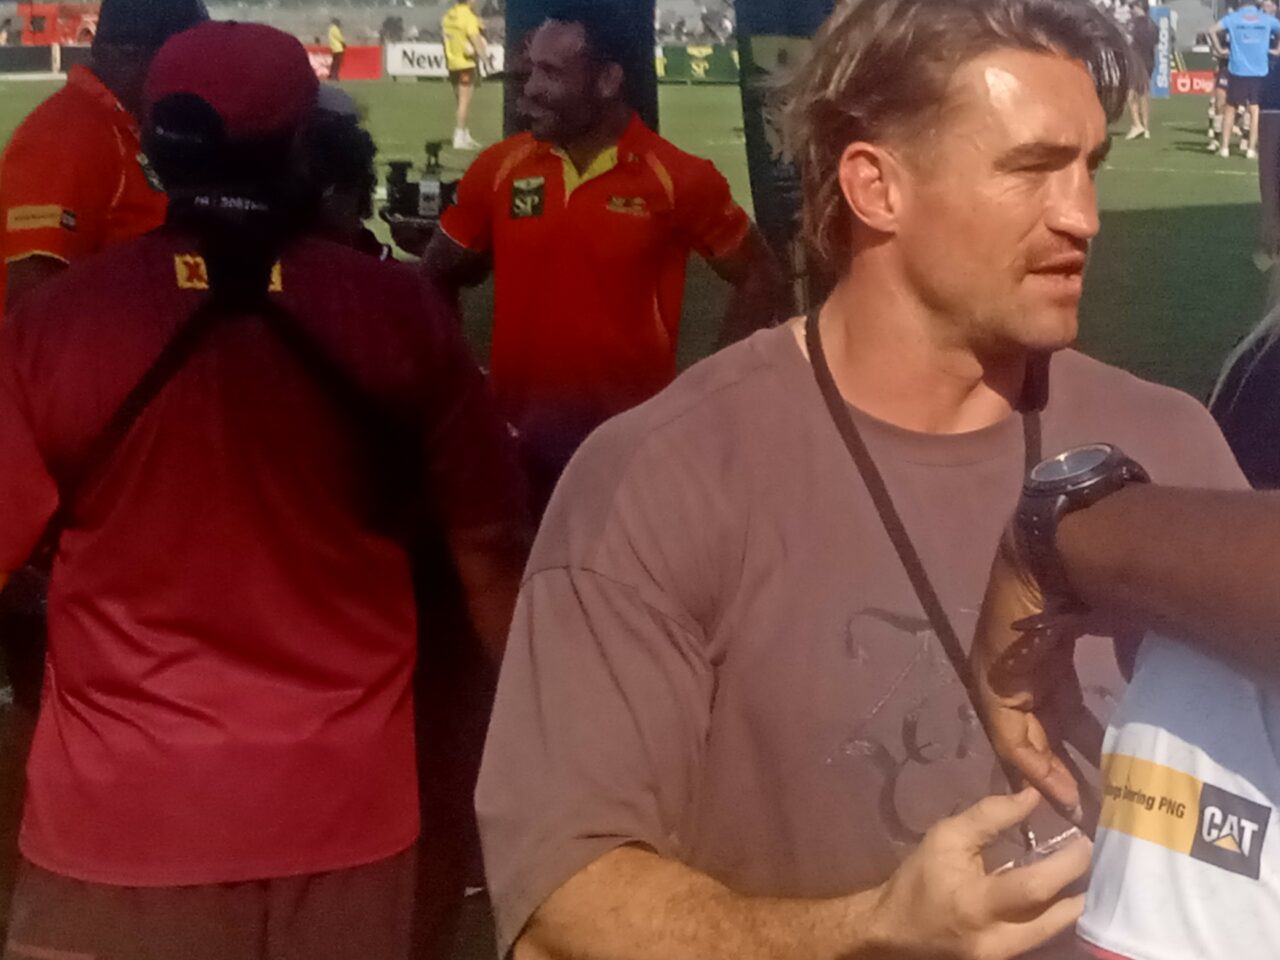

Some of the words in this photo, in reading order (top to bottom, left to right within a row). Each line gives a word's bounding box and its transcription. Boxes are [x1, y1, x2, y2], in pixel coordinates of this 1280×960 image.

[1156, 16, 1169, 88] Santos
[1158, 795, 1186, 818] PNG
[1202, 806, 1259, 857] CAT
